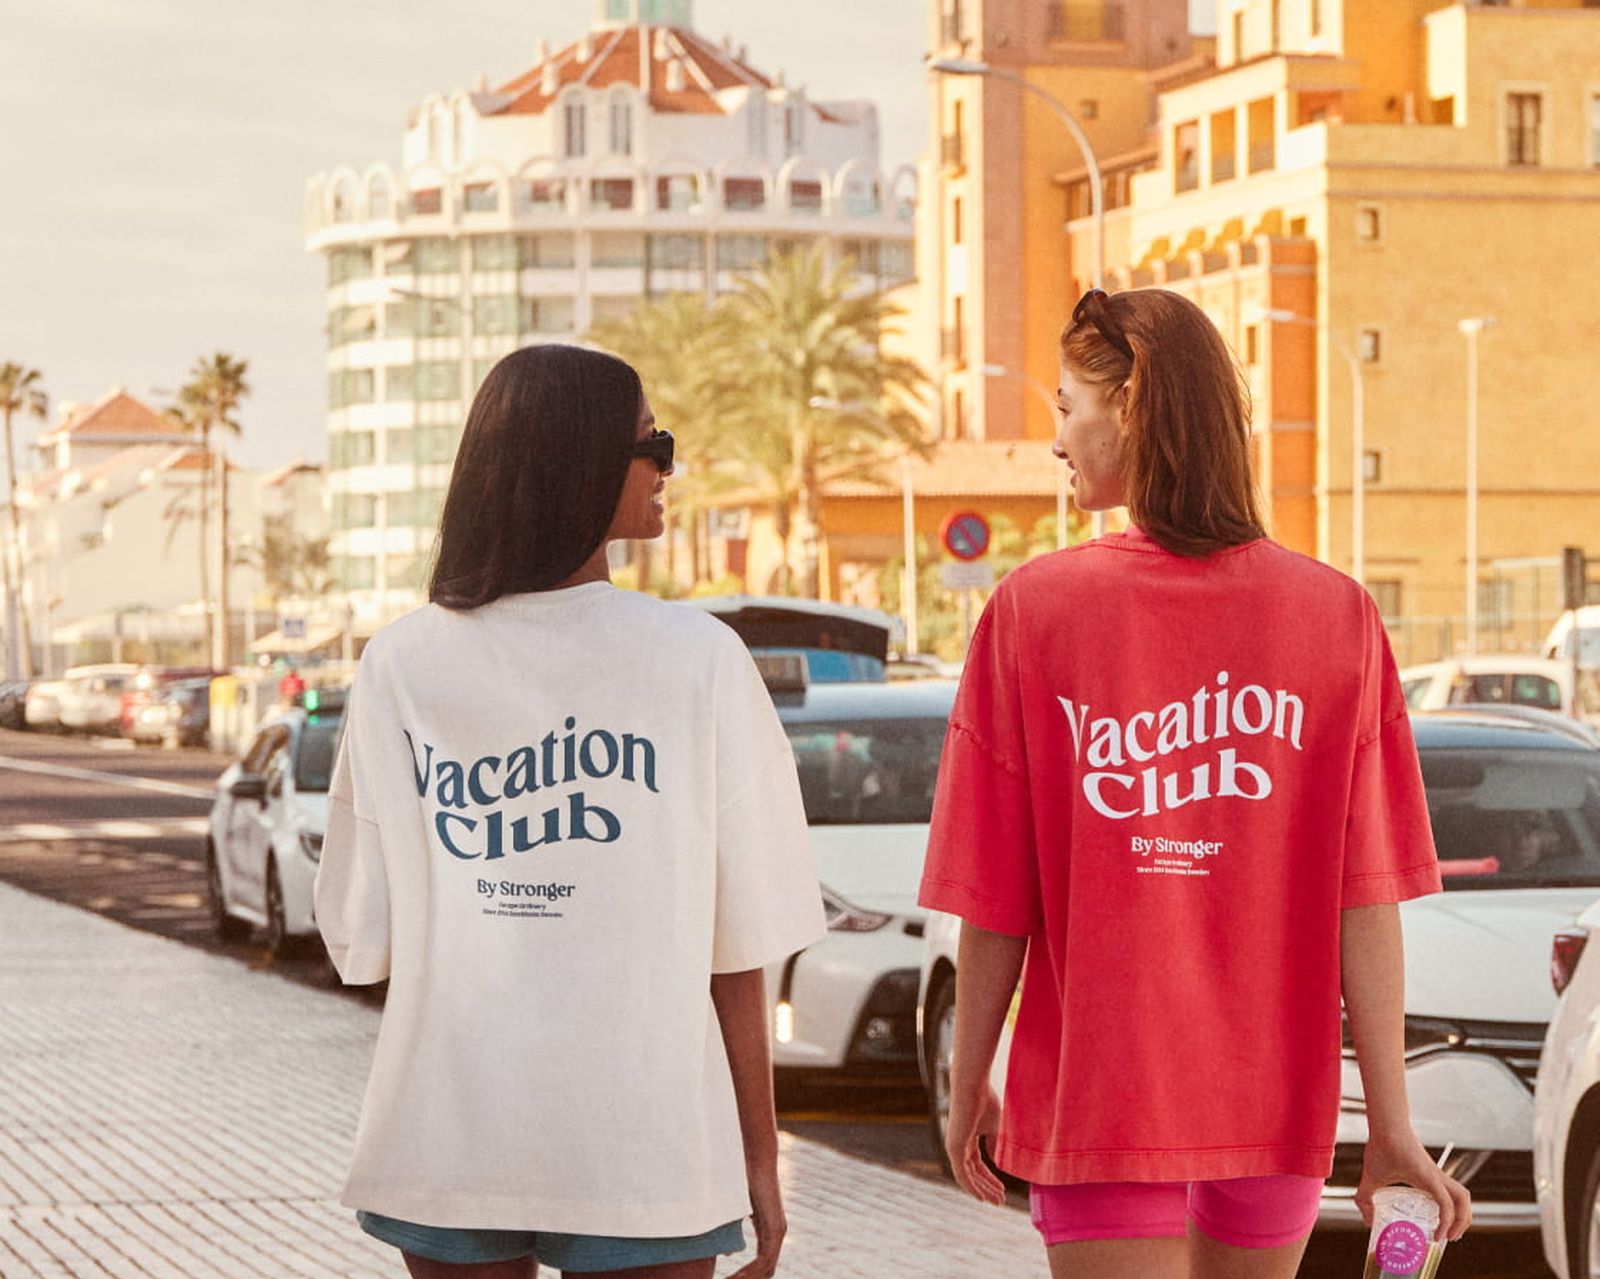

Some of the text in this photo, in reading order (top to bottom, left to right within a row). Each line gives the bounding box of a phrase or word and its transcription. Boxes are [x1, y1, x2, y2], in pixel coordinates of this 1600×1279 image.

[1056, 670, 1304, 768] Vacation
[403, 716, 659, 809] Vacation
[1082, 748, 1273, 819] Club
[434, 791, 621, 860] Club
[1131, 836, 1224, 859] By Stronger
[477, 878, 576, 902] By Stronger
